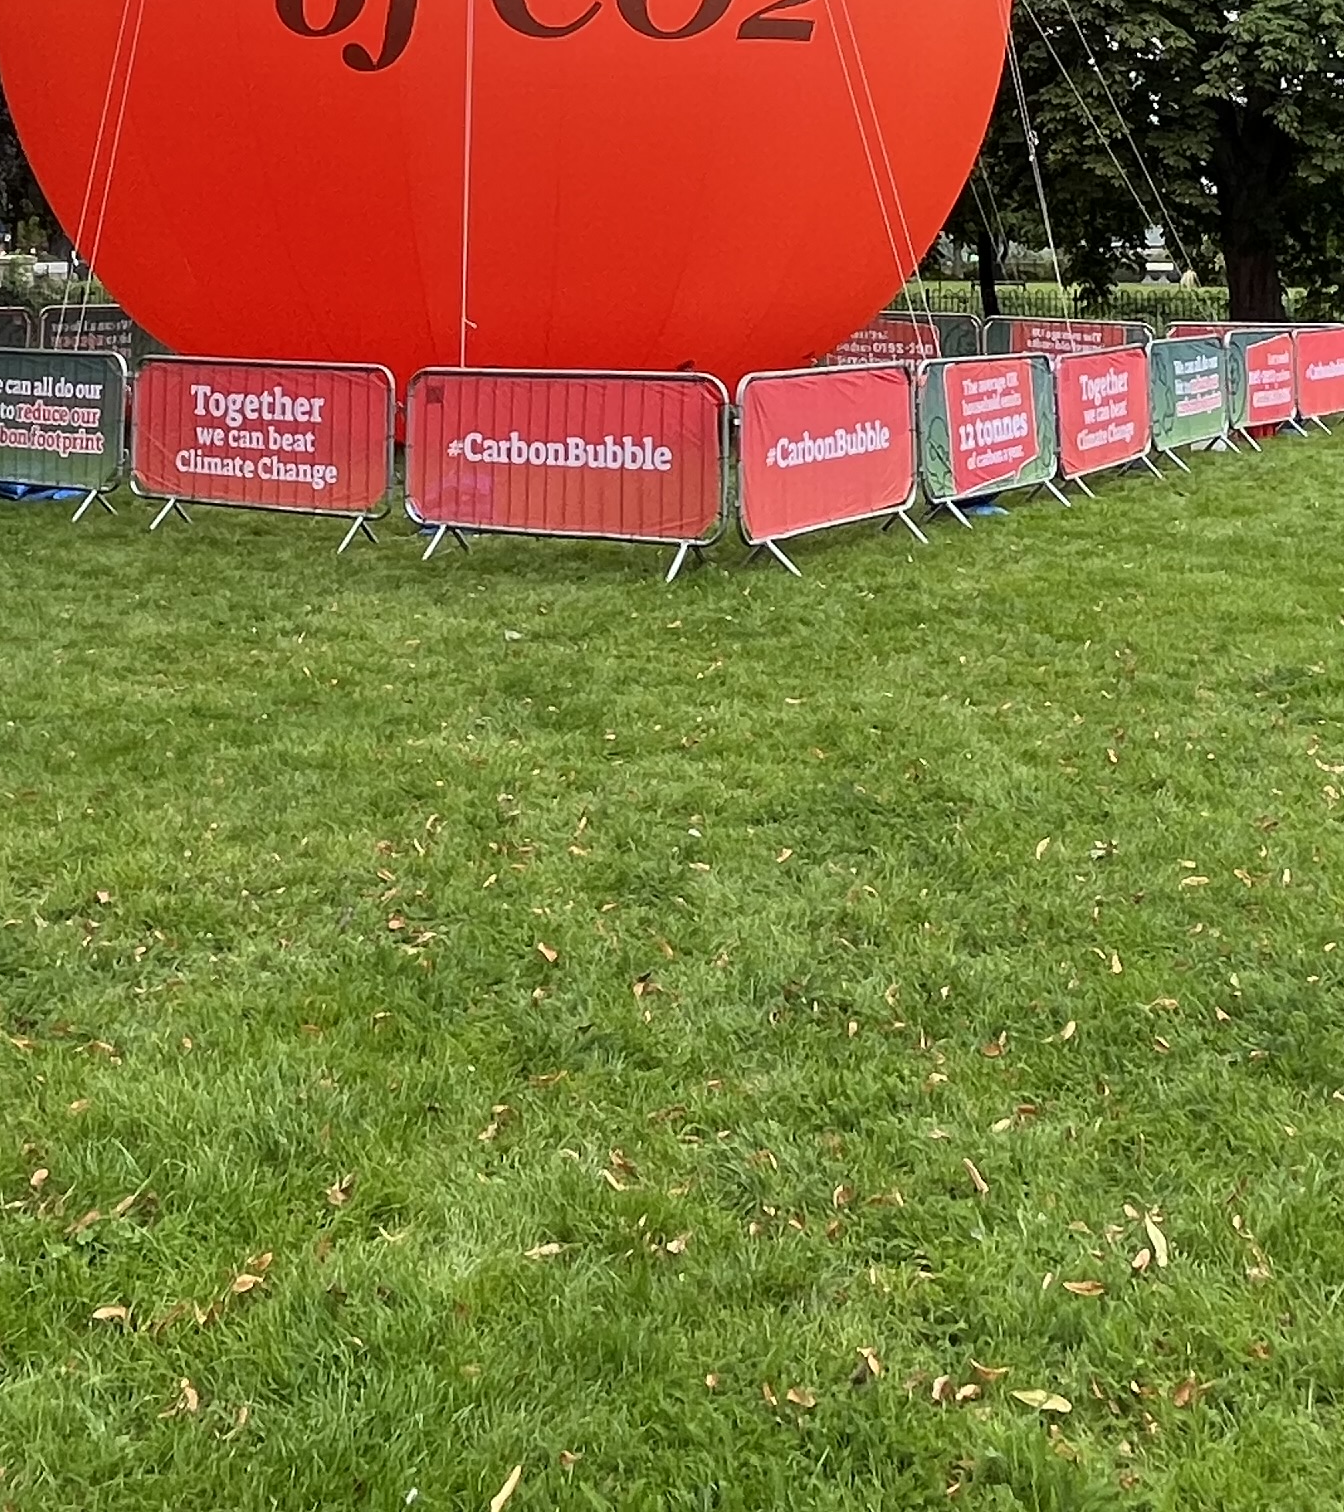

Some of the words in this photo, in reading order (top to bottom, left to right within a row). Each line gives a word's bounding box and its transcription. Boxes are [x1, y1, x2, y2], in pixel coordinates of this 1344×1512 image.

[6, 379, 32, 395] can
[33, 376, 53, 397] all
[55, 377, 73, 398] do
[75, 383, 103, 399] our
[190, 384, 325, 427] Together
[1079, 367, 1128, 406] Together
[0, 402, 15, 419] to
[16, 400, 69, 425] reduce
[70, 407, 101, 427] our
[959, 423, 976, 451] 12
[976, 413, 1028, 447] tonnes
[28, 425, 104, 457] footprint
[196, 427, 225, 445] we
[228, 429, 265, 449] can
[268, 426, 315, 452] beat
[447, 432, 672, 470] #CarbonBubble
[766, 419, 890, 468] #CarbonBubble
[176, 449, 255, 477] Climate
[257, 456, 337, 489] Change
